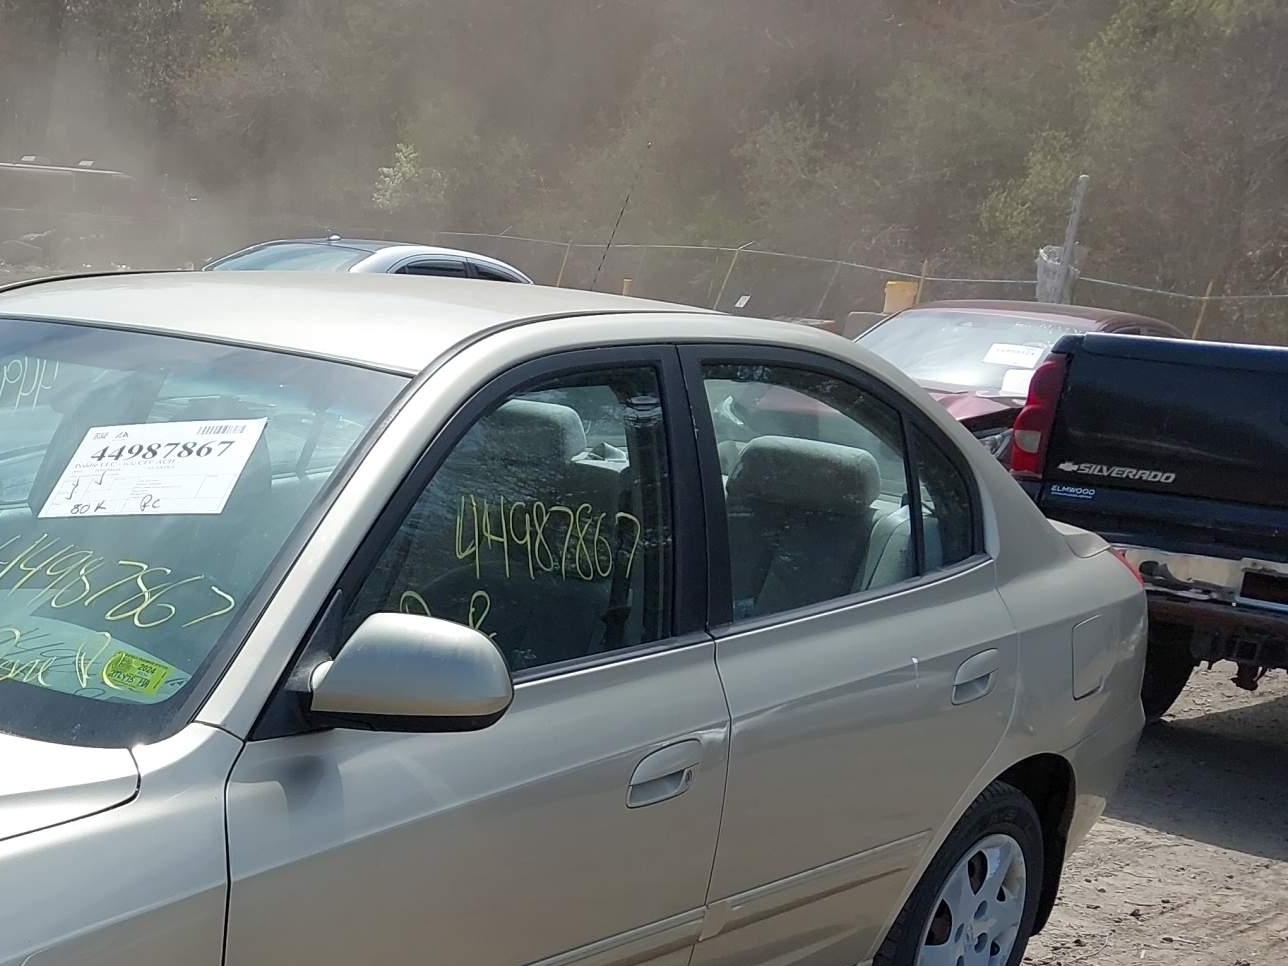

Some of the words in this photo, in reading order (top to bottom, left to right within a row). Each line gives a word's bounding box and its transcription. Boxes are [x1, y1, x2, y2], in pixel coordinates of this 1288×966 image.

[90, 439, 236, 462] 44987867
[1077, 463, 1176, 483] SILVERADO
[1051, 484, 1096, 495] ELMWOOD
[455, 494, 642, 581] 44987867
